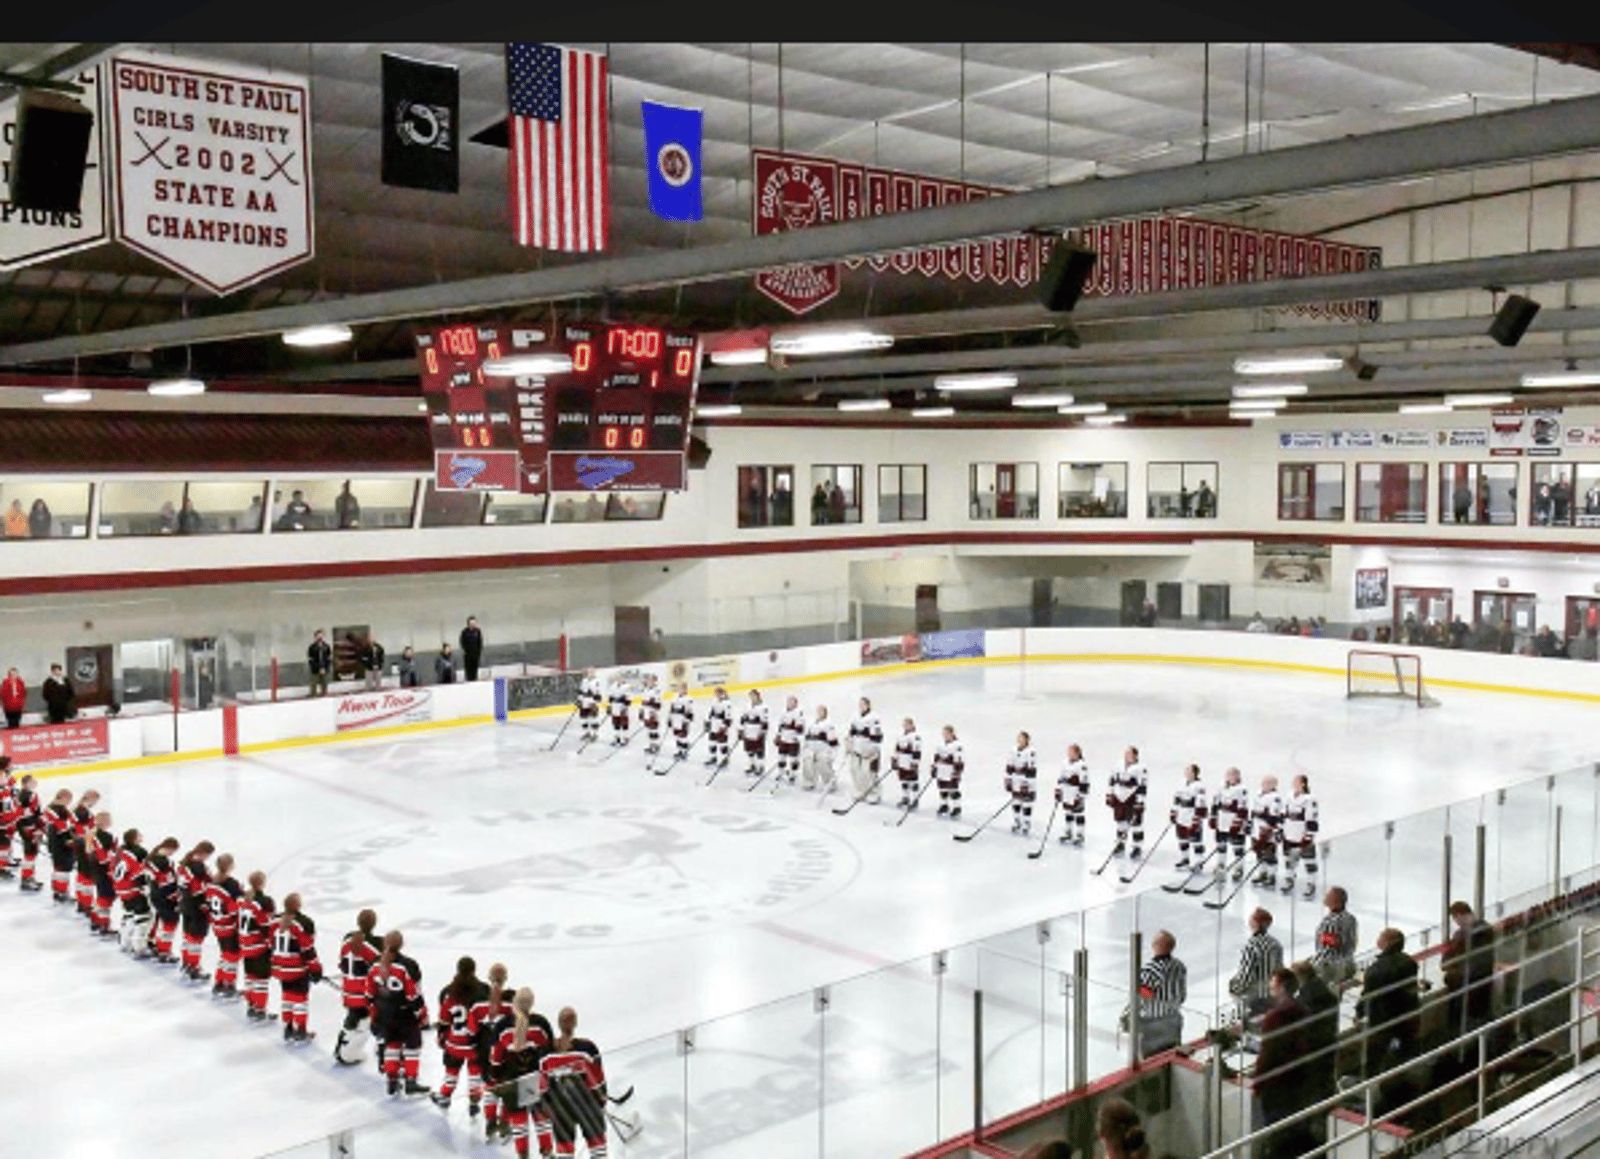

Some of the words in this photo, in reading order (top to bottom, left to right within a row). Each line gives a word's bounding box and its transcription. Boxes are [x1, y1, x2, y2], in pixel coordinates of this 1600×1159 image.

[120, 68, 200, 101] SOUTH
[205, 81, 235, 105] ST
[240, 87, 299, 114] PAUL
[133, 107, 195, 132] GIRLS
[208, 117, 290, 145] VARSITY
[175, 144, 256, 175] 2002
[154, 179, 235, 208] STATE
[246, 190, 278, 213] AA
[761, 167, 790, 218] SOUTH
[810, 174, 833, 221] PAUL
[146, 214, 288, 248] CHAMPIONS
[573, 343, 591, 371] 0
[608, 328, 660, 358] 17:00
[676, 350, 692, 376] 0
